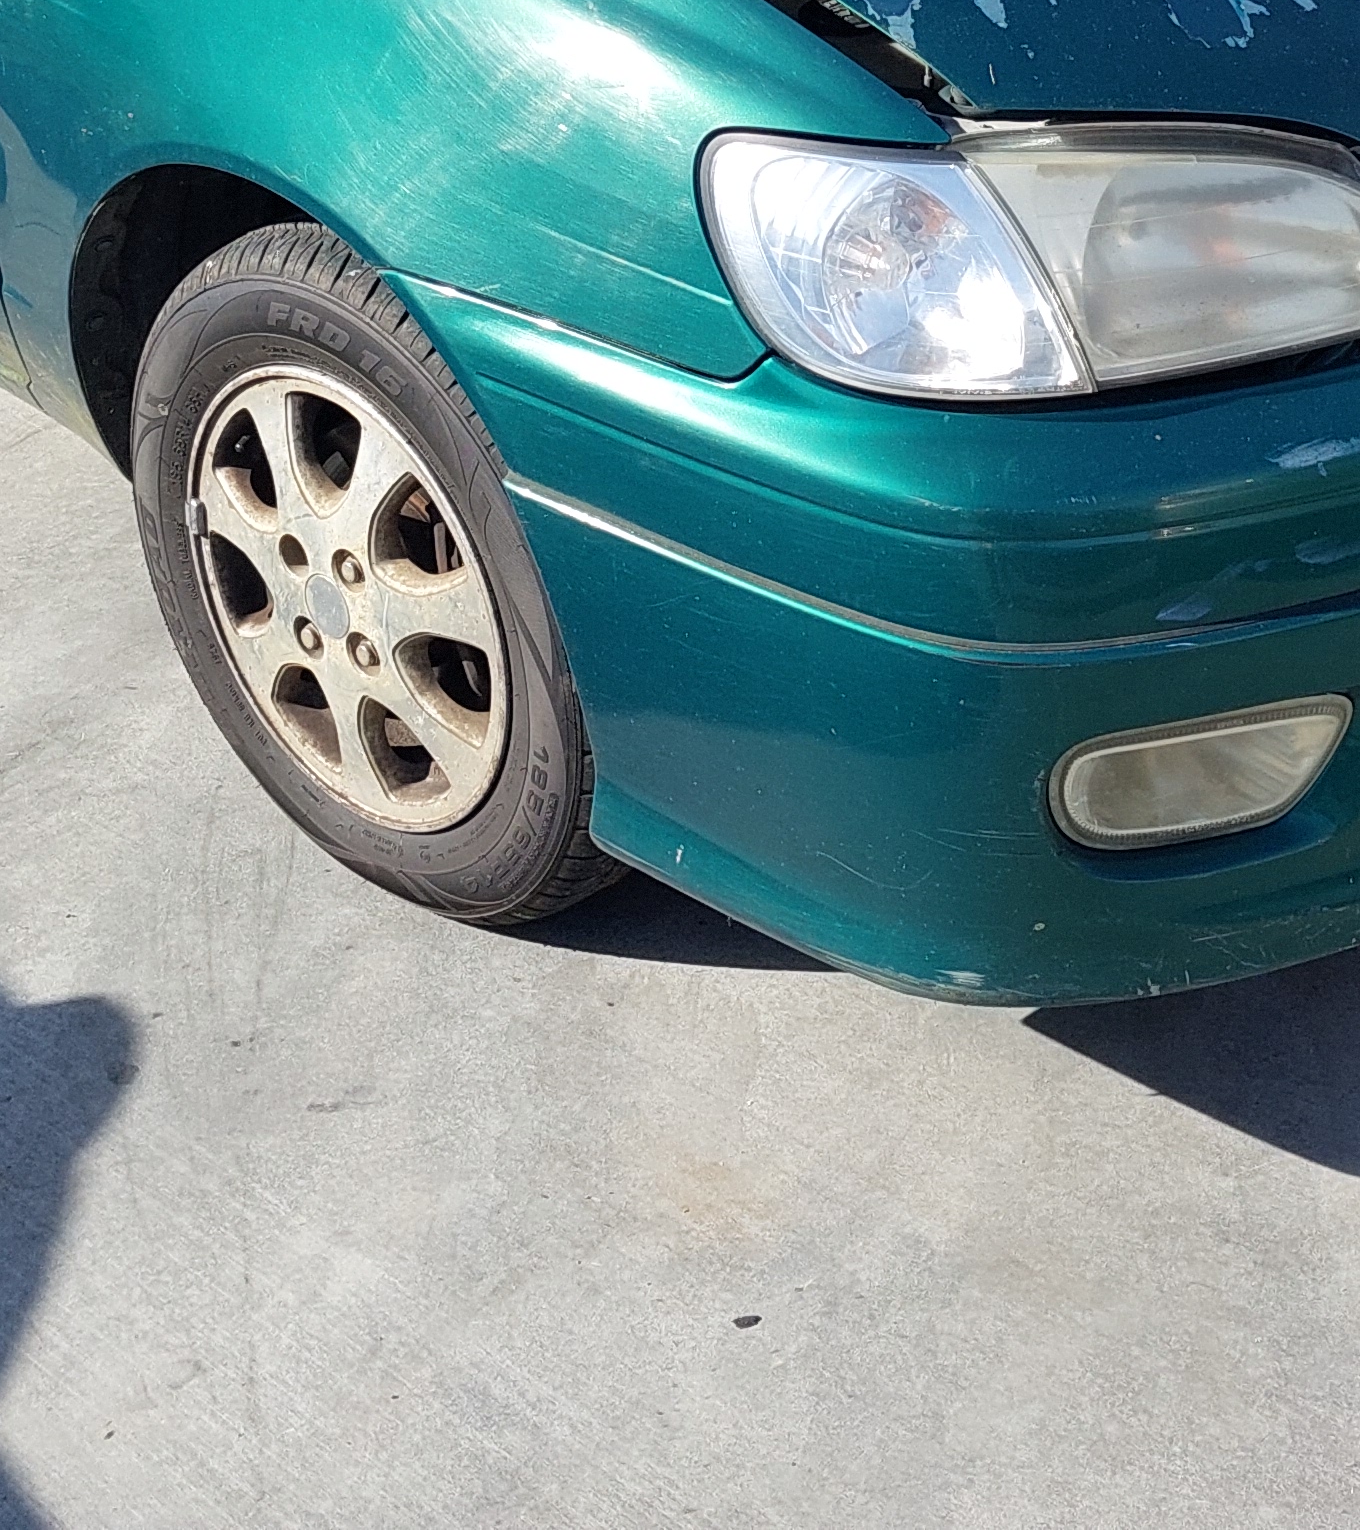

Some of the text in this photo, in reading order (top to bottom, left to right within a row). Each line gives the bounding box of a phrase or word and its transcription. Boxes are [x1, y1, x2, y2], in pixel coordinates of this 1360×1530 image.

[266, 301, 351, 352] FRD
[359, 348, 408, 398] 16
[461, 745, 550, 893] 185/65R14
